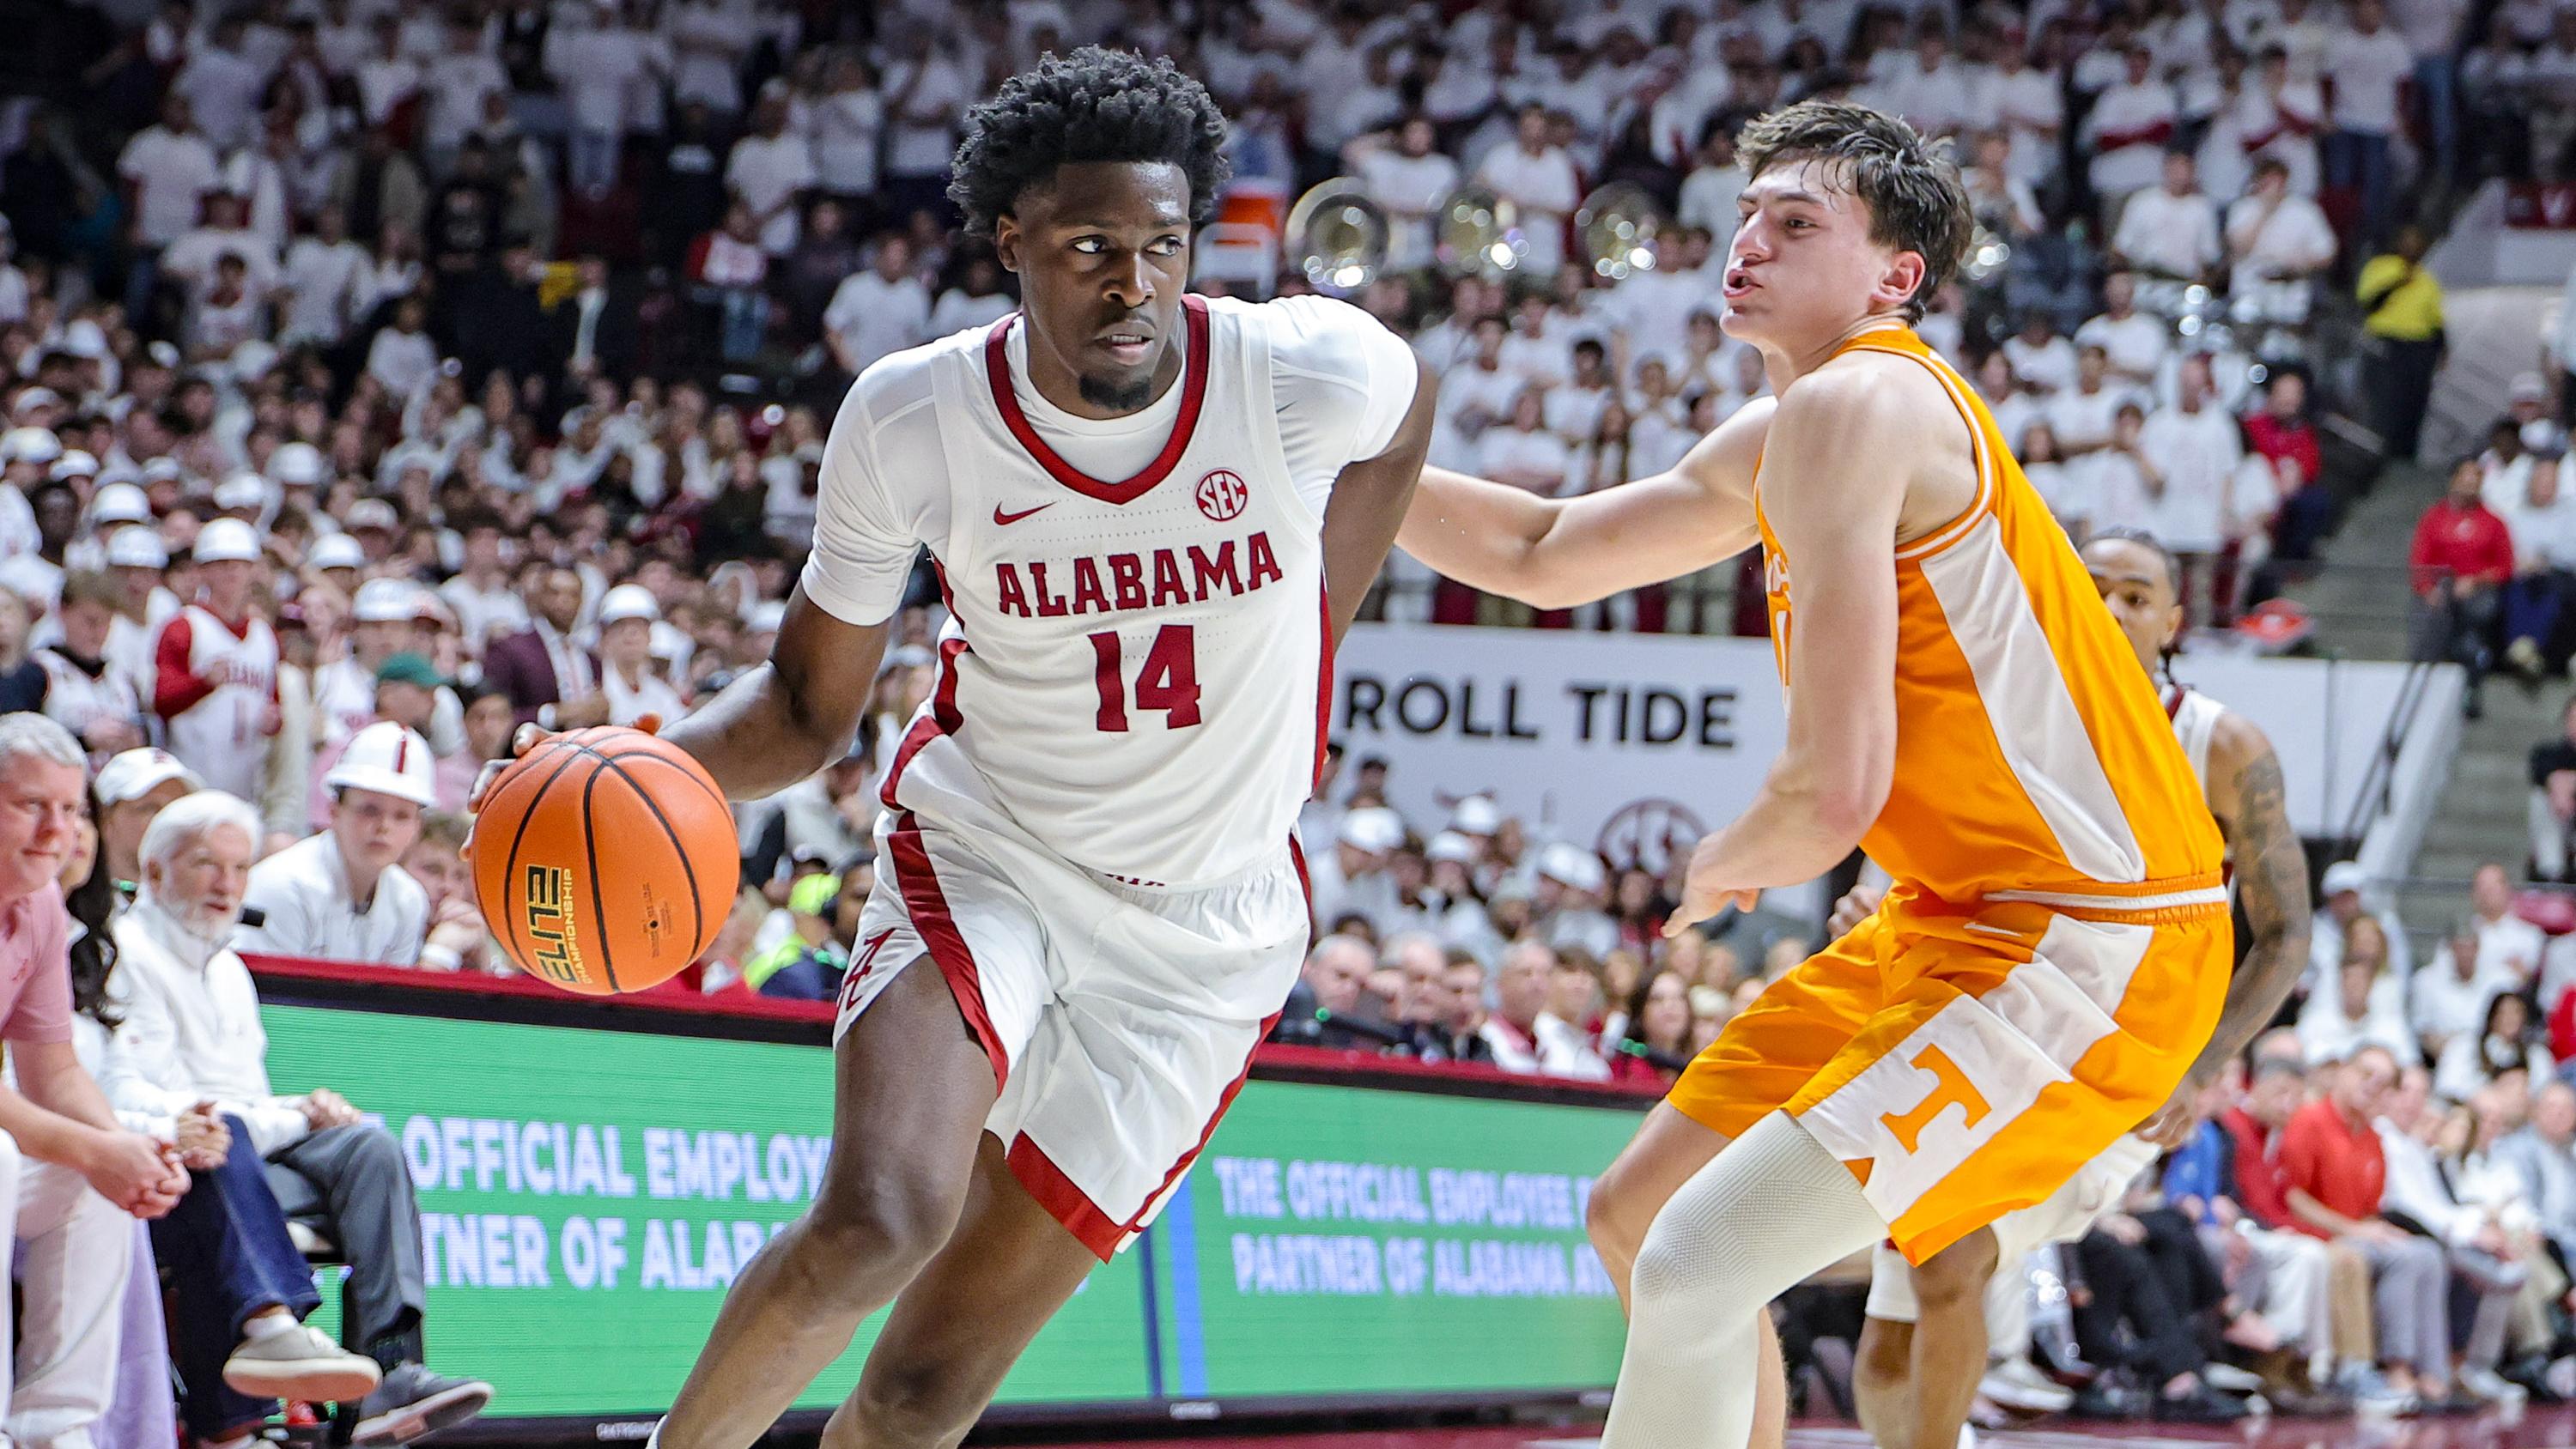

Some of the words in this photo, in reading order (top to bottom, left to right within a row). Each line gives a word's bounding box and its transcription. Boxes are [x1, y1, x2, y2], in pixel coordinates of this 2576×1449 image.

[1199, 474, 1248, 519] SEC
[995, 530, 1283, 618] ALABAMA
[1088, 624, 1202, 732] 14
[1345, 677, 1538, 739] ROLL
[1570, 685, 1738, 748] TIDE
[526, 864, 579, 985] ELITE
[1880, 1042, 1992, 1156] T
[401, 1113, 636, 1197] OFFICIAL
[1212, 1155, 1284, 1218] THE
[1286, 1159, 1429, 1225] OFFICIAL
[1430, 1167, 1574, 1229] EMPLOYEE
[560, 1215, 629, 1290] OF
[1231, 1234, 1383, 1294] PARTNER
[1384, 1236, 1429, 1295] OF
[1432, 1240, 1571, 1296] ALABAMA
